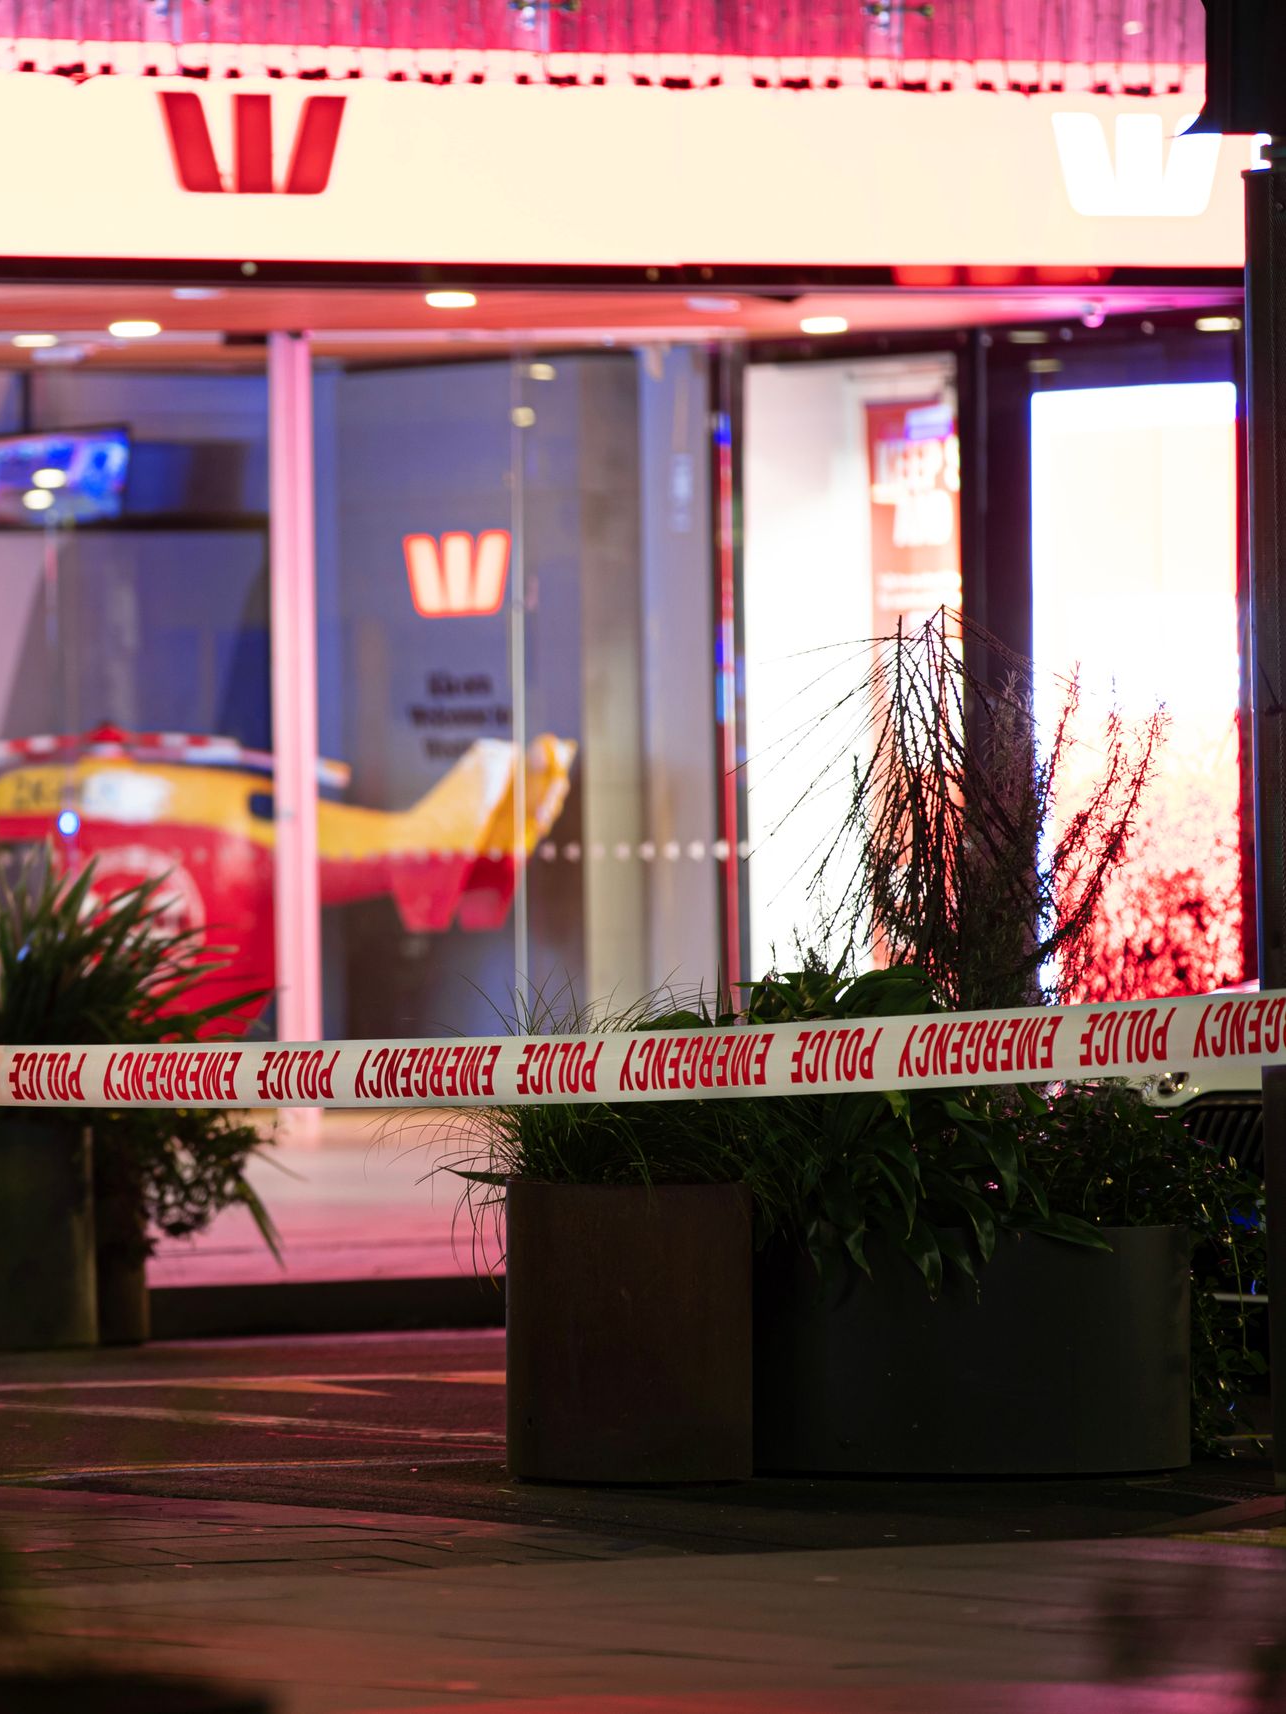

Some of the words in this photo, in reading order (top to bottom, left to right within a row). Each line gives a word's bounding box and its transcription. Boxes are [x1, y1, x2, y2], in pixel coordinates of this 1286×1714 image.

[898, 1015, 1063, 1077] EMERGENCY
[1079, 1007, 1177, 1066] POLICE
[1193, 996, 1286, 1058] GENCY
[8, 1052, 87, 1101] POLICE
[103, 1050, 243, 1102] EMERGENCY
[256, 1050, 341, 1101] POLICE
[354, 1046, 502, 1099] EMERGENCY
[516, 1041, 604, 1096] POLICE
[619, 1033, 775, 1092] EMERGENCY
[790, 1027, 884, 1084] POLICE
